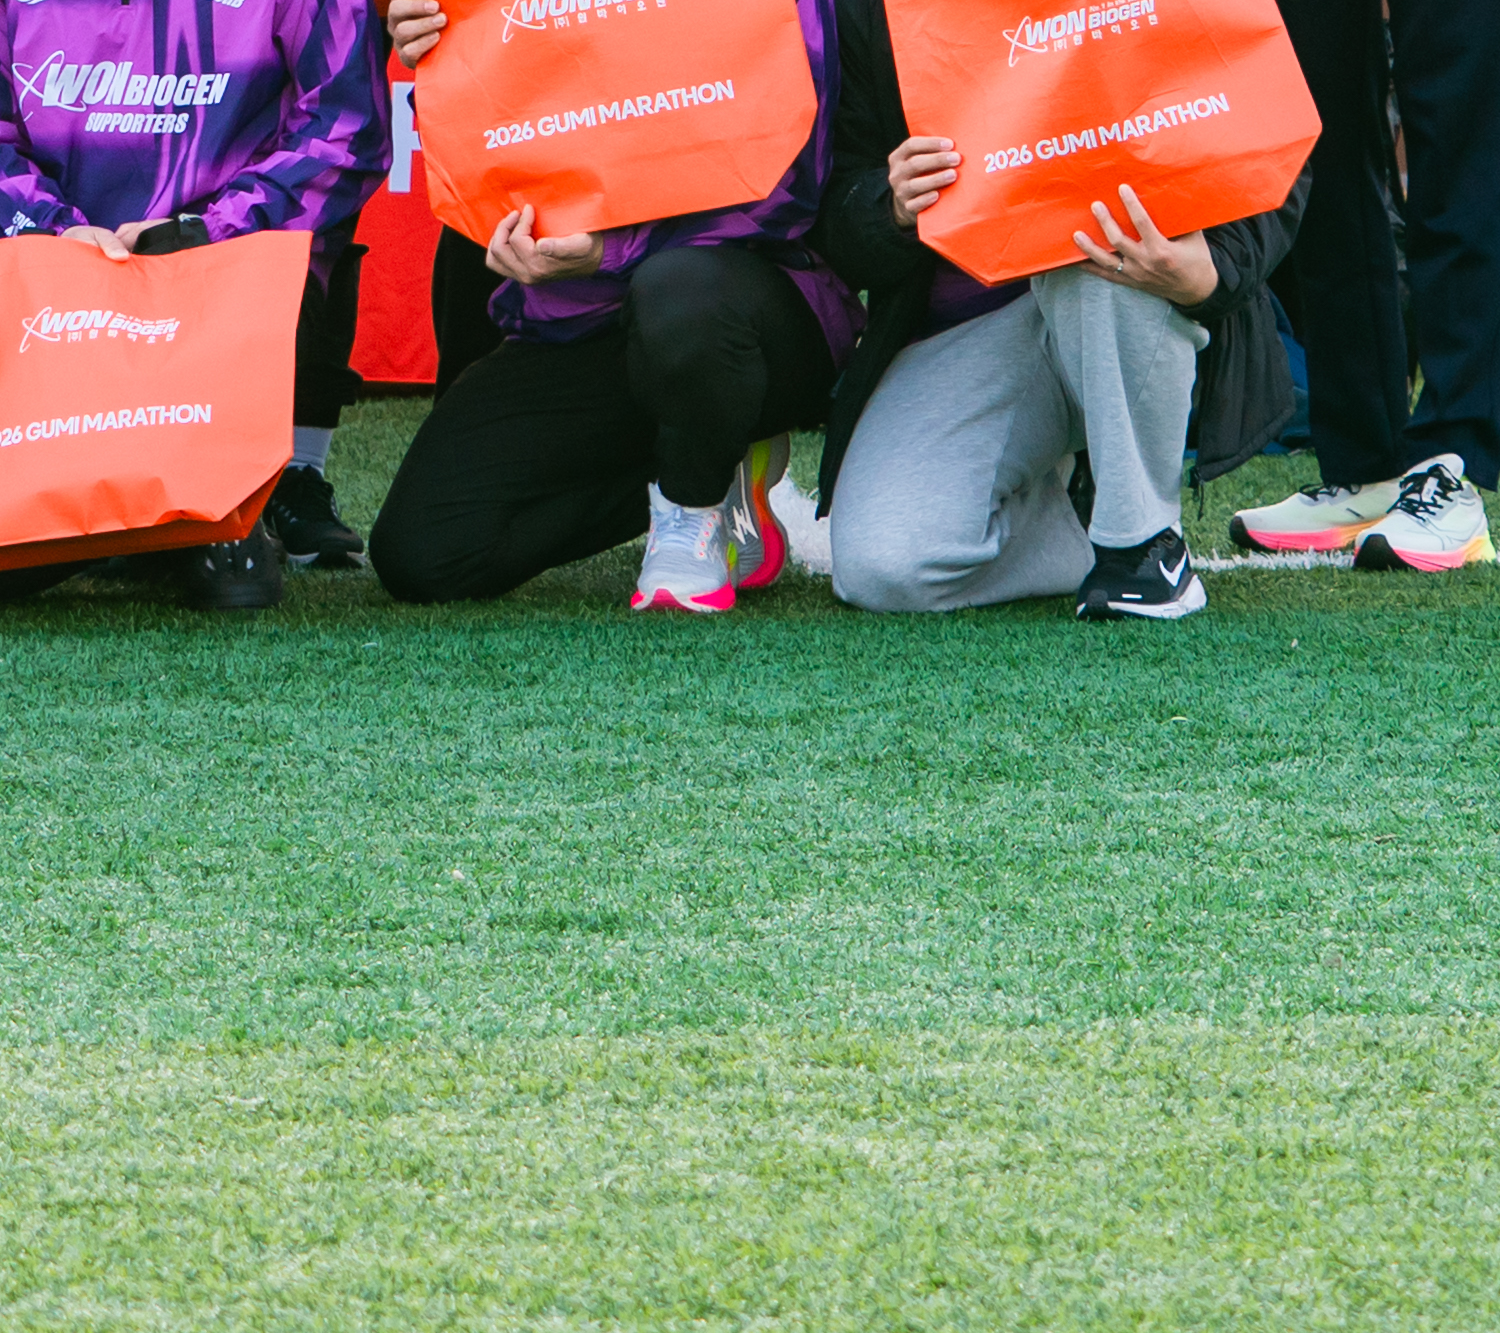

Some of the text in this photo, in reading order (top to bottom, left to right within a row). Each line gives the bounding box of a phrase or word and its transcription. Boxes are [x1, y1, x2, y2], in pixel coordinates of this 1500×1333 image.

[1025, 9, 1085, 46] WON
[42, 61, 230, 107] WON BIOGEN
[85, 112, 189, 133] SUPPORTERS
[483, 79, 735, 149] 2026 GUMI MARATHON
[984, 92, 1231, 173] 2026 GUMI MARATHON
[41, 309, 180, 336] WON BIOGEN
[25, 415, 80, 441] GUMI
[82, 404, 212, 434] MARATHON
